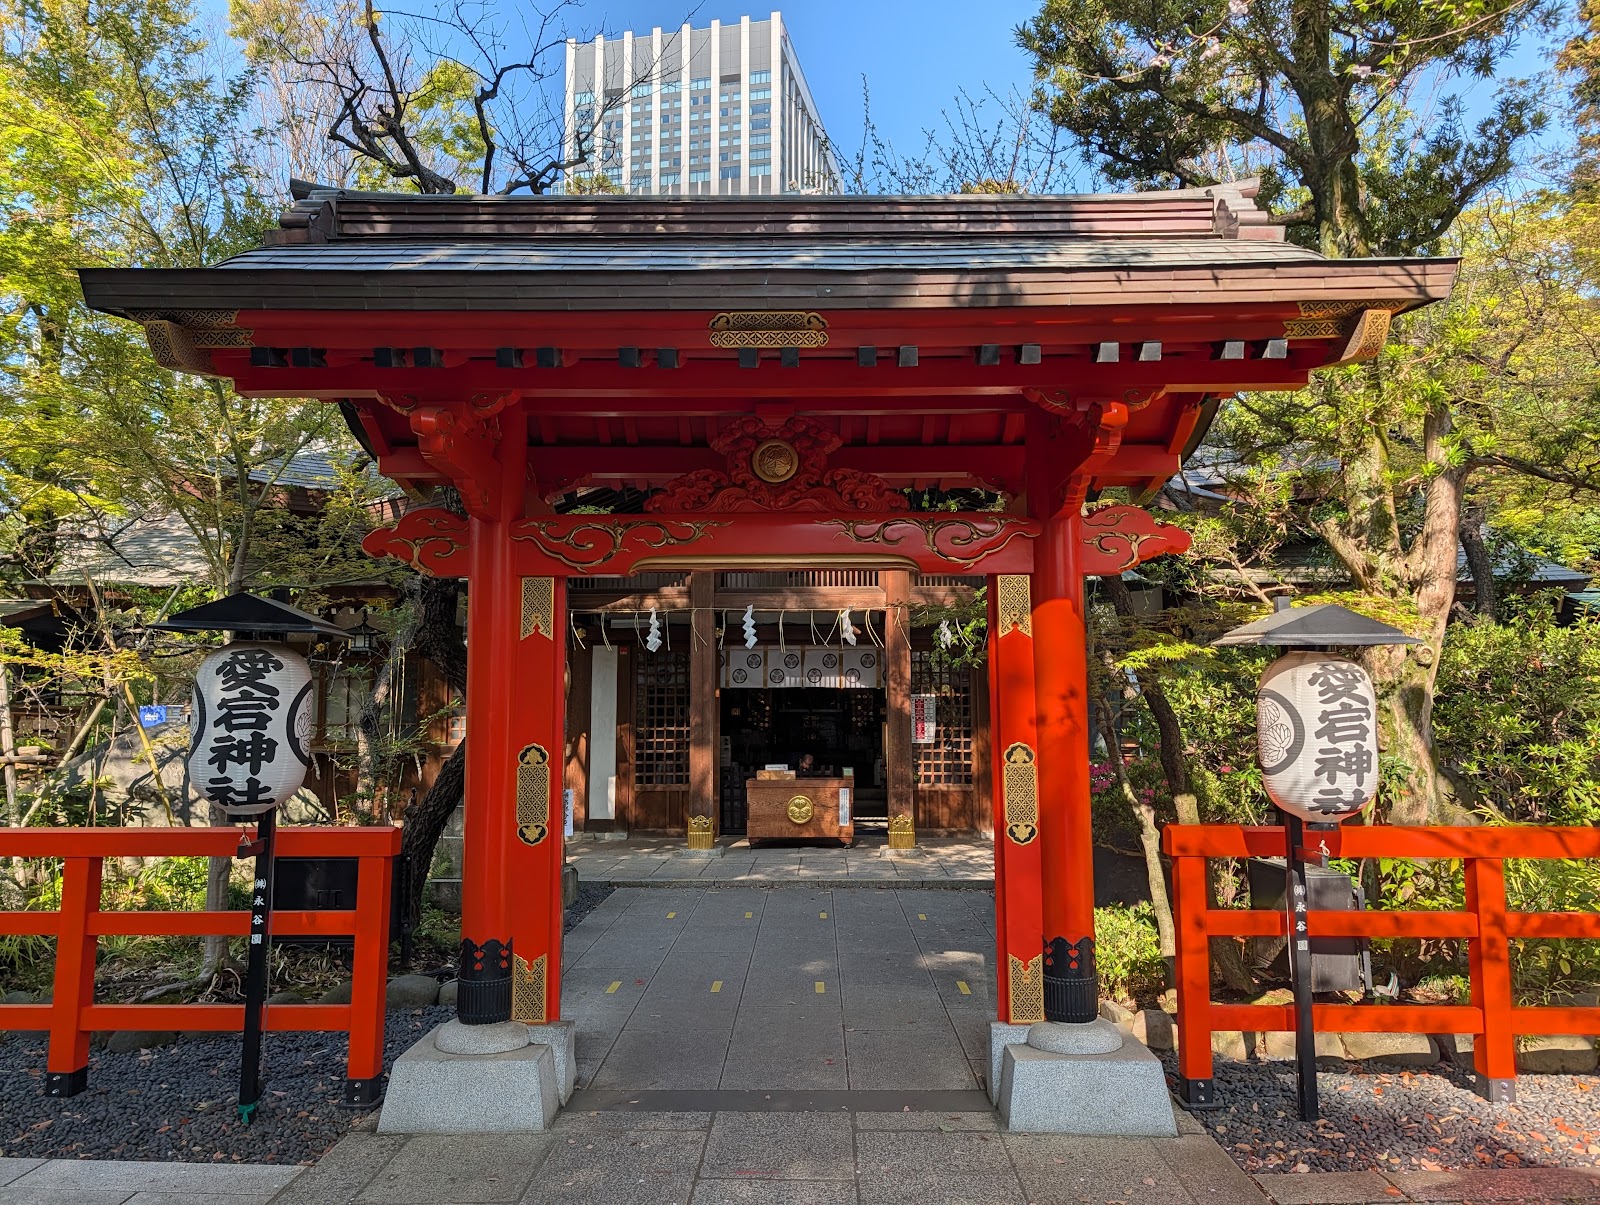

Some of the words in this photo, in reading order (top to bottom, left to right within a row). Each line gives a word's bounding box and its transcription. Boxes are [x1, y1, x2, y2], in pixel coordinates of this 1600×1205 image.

[206, 649, 284, 807] 愛宕神社
[1307, 662, 1373, 815] 愛宕神社
